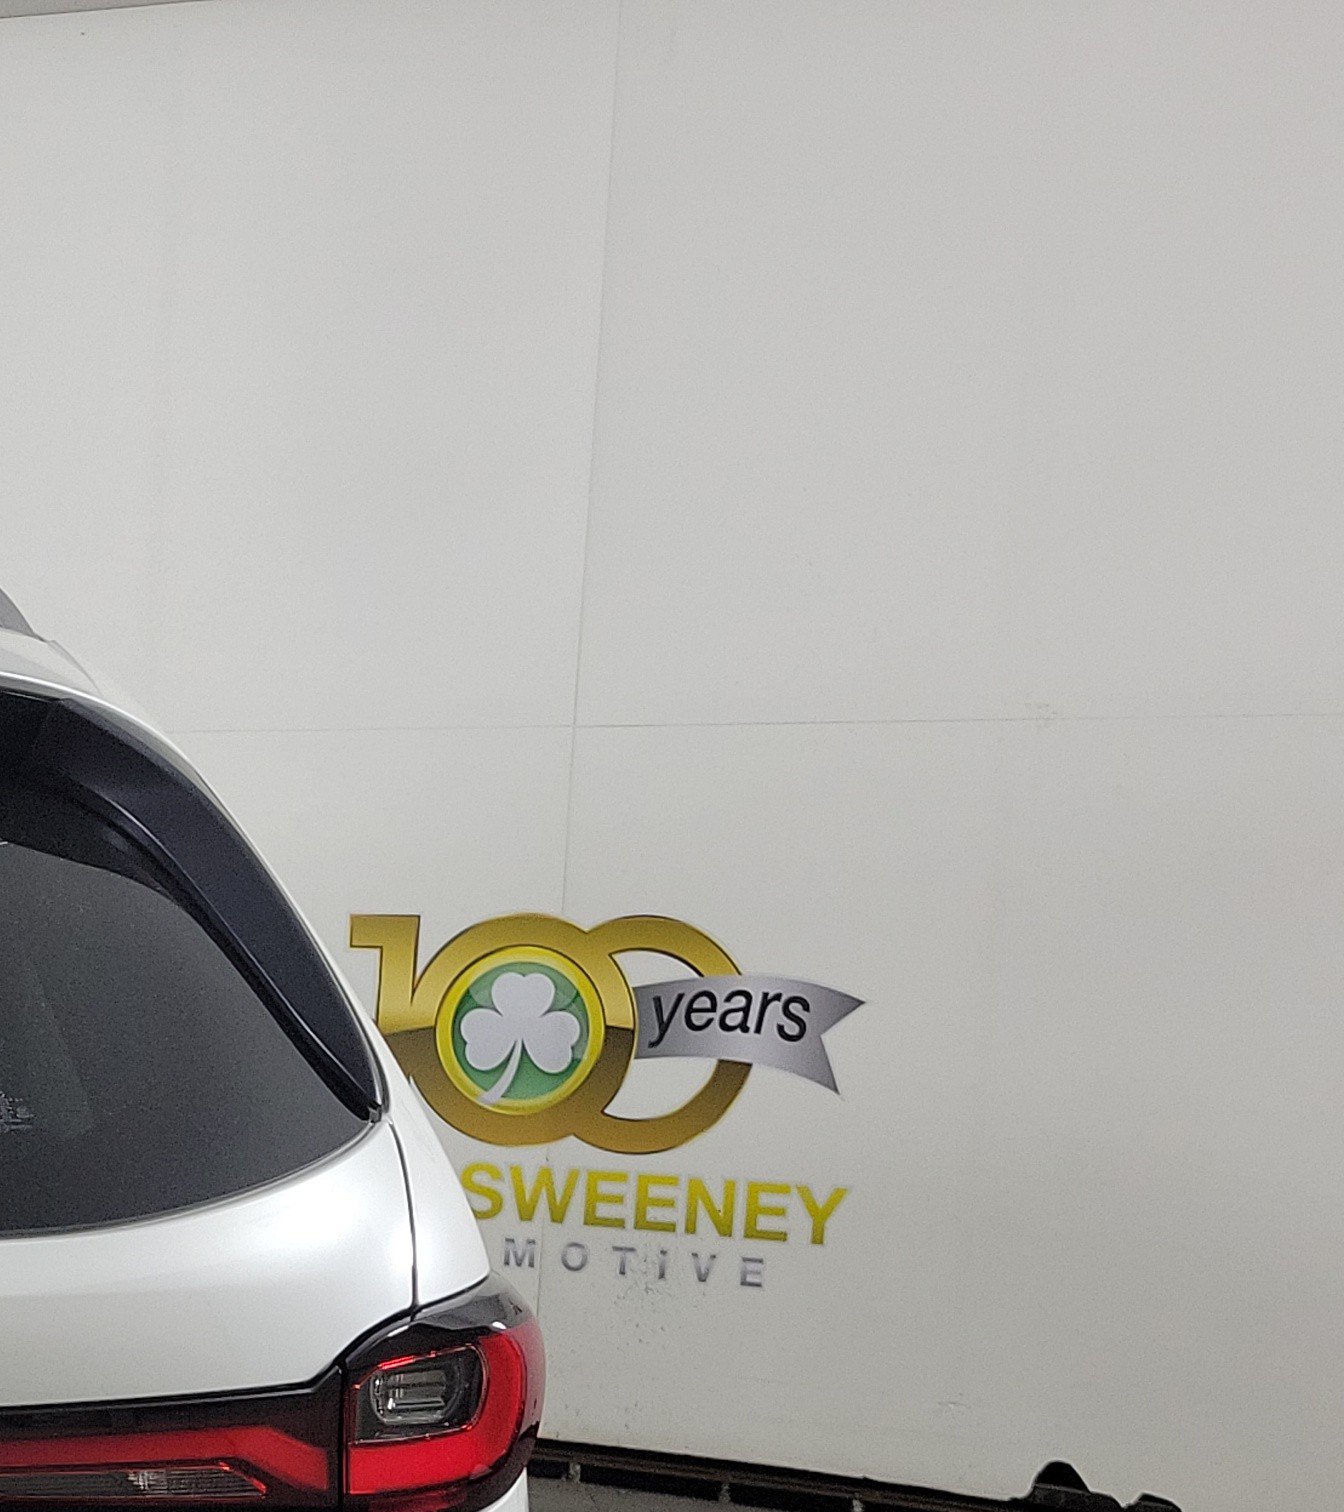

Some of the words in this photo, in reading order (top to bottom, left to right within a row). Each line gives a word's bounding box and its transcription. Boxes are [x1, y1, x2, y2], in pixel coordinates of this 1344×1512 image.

[648, 989, 810, 1048] years
[460, 1162, 848, 1245] SWEENEY
[503, 1237, 765, 1288] MOTIVE
